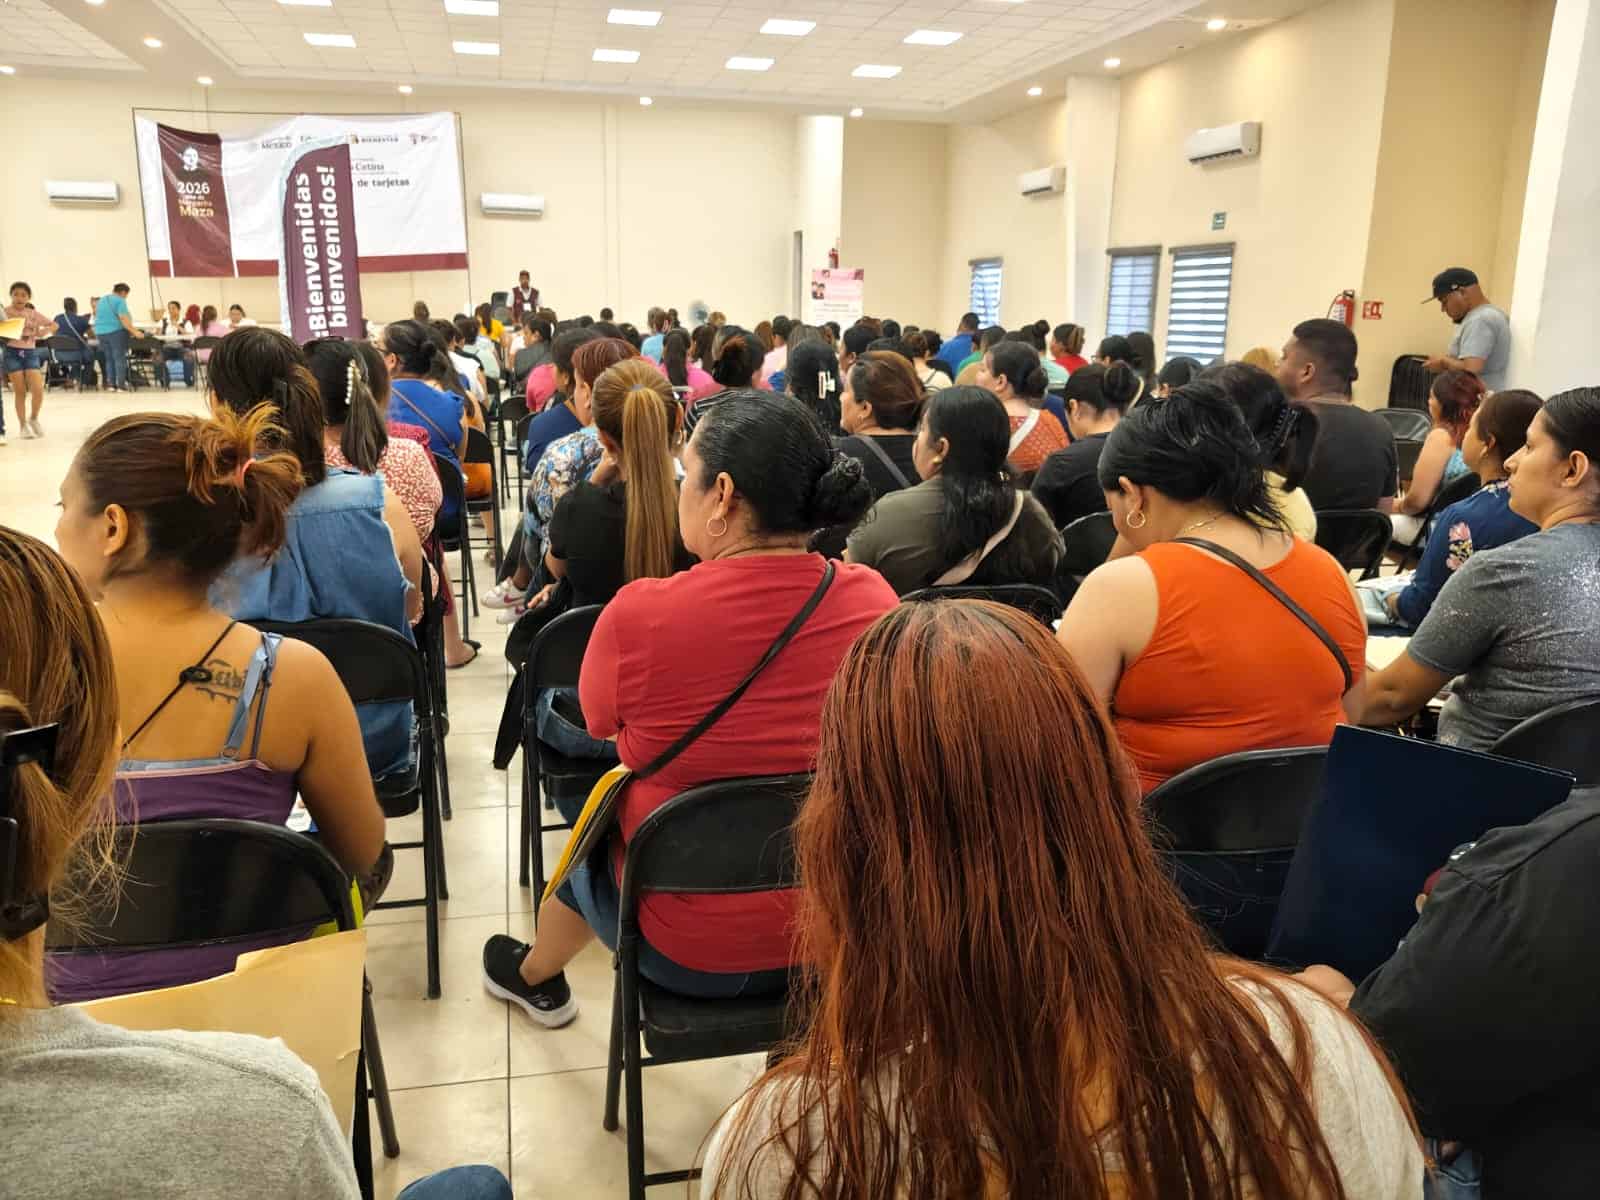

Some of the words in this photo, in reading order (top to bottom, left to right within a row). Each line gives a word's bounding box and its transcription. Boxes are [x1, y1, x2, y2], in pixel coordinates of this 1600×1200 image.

[177, 182, 210, 194] 2026
[357, 179, 368, 187] de
[372, 177, 410, 188] tarjetas
[179, 206, 214, 217] Maza
[316, 166, 348, 328] bienvenidos!
